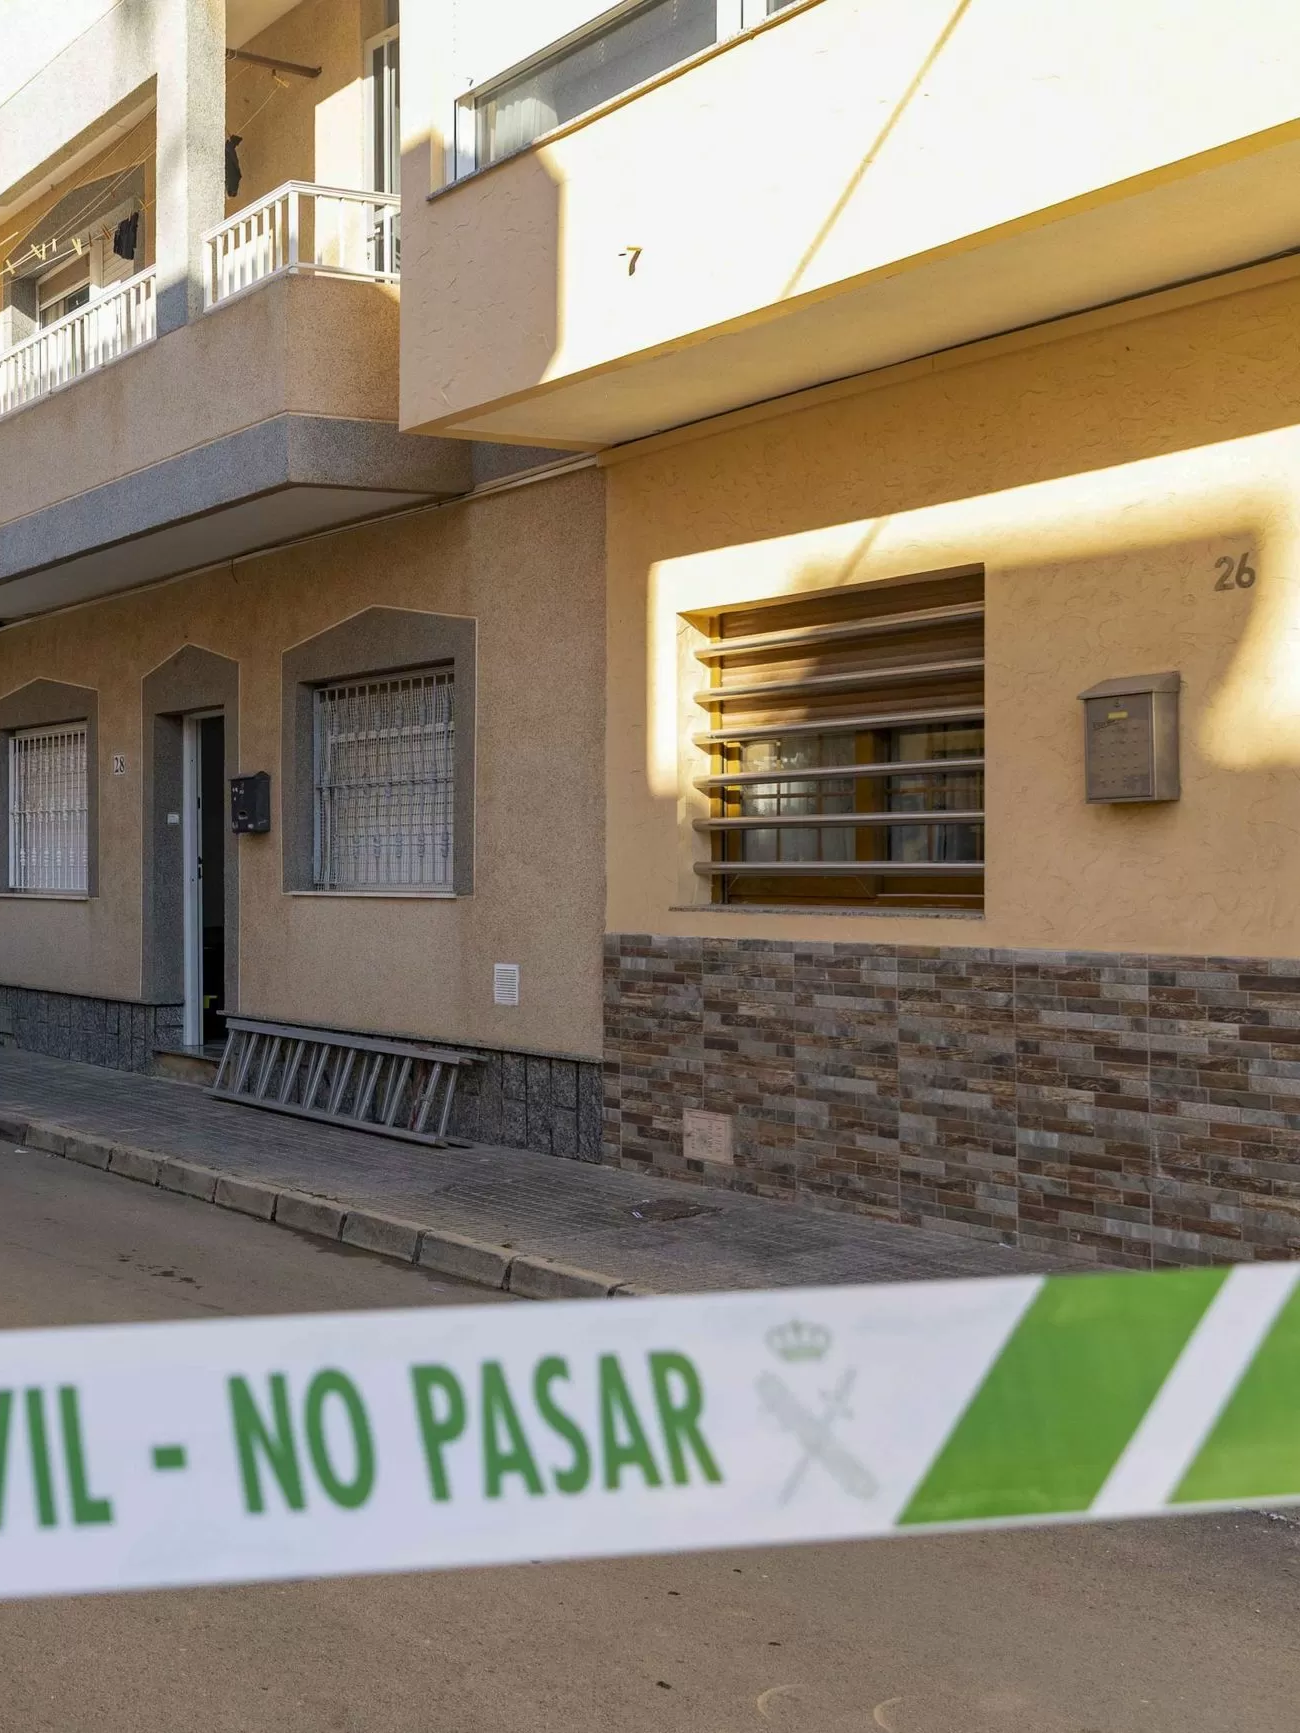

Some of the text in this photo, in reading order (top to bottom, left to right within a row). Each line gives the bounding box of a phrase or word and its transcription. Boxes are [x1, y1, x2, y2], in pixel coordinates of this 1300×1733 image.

[1213, 551, 1256, 592] 26
[114, 756, 125, 773] 28
[151, 1443, 188, 1472] -
[226, 1366, 376, 1516] NO
[409, 1349, 725, 1503] PASAR
